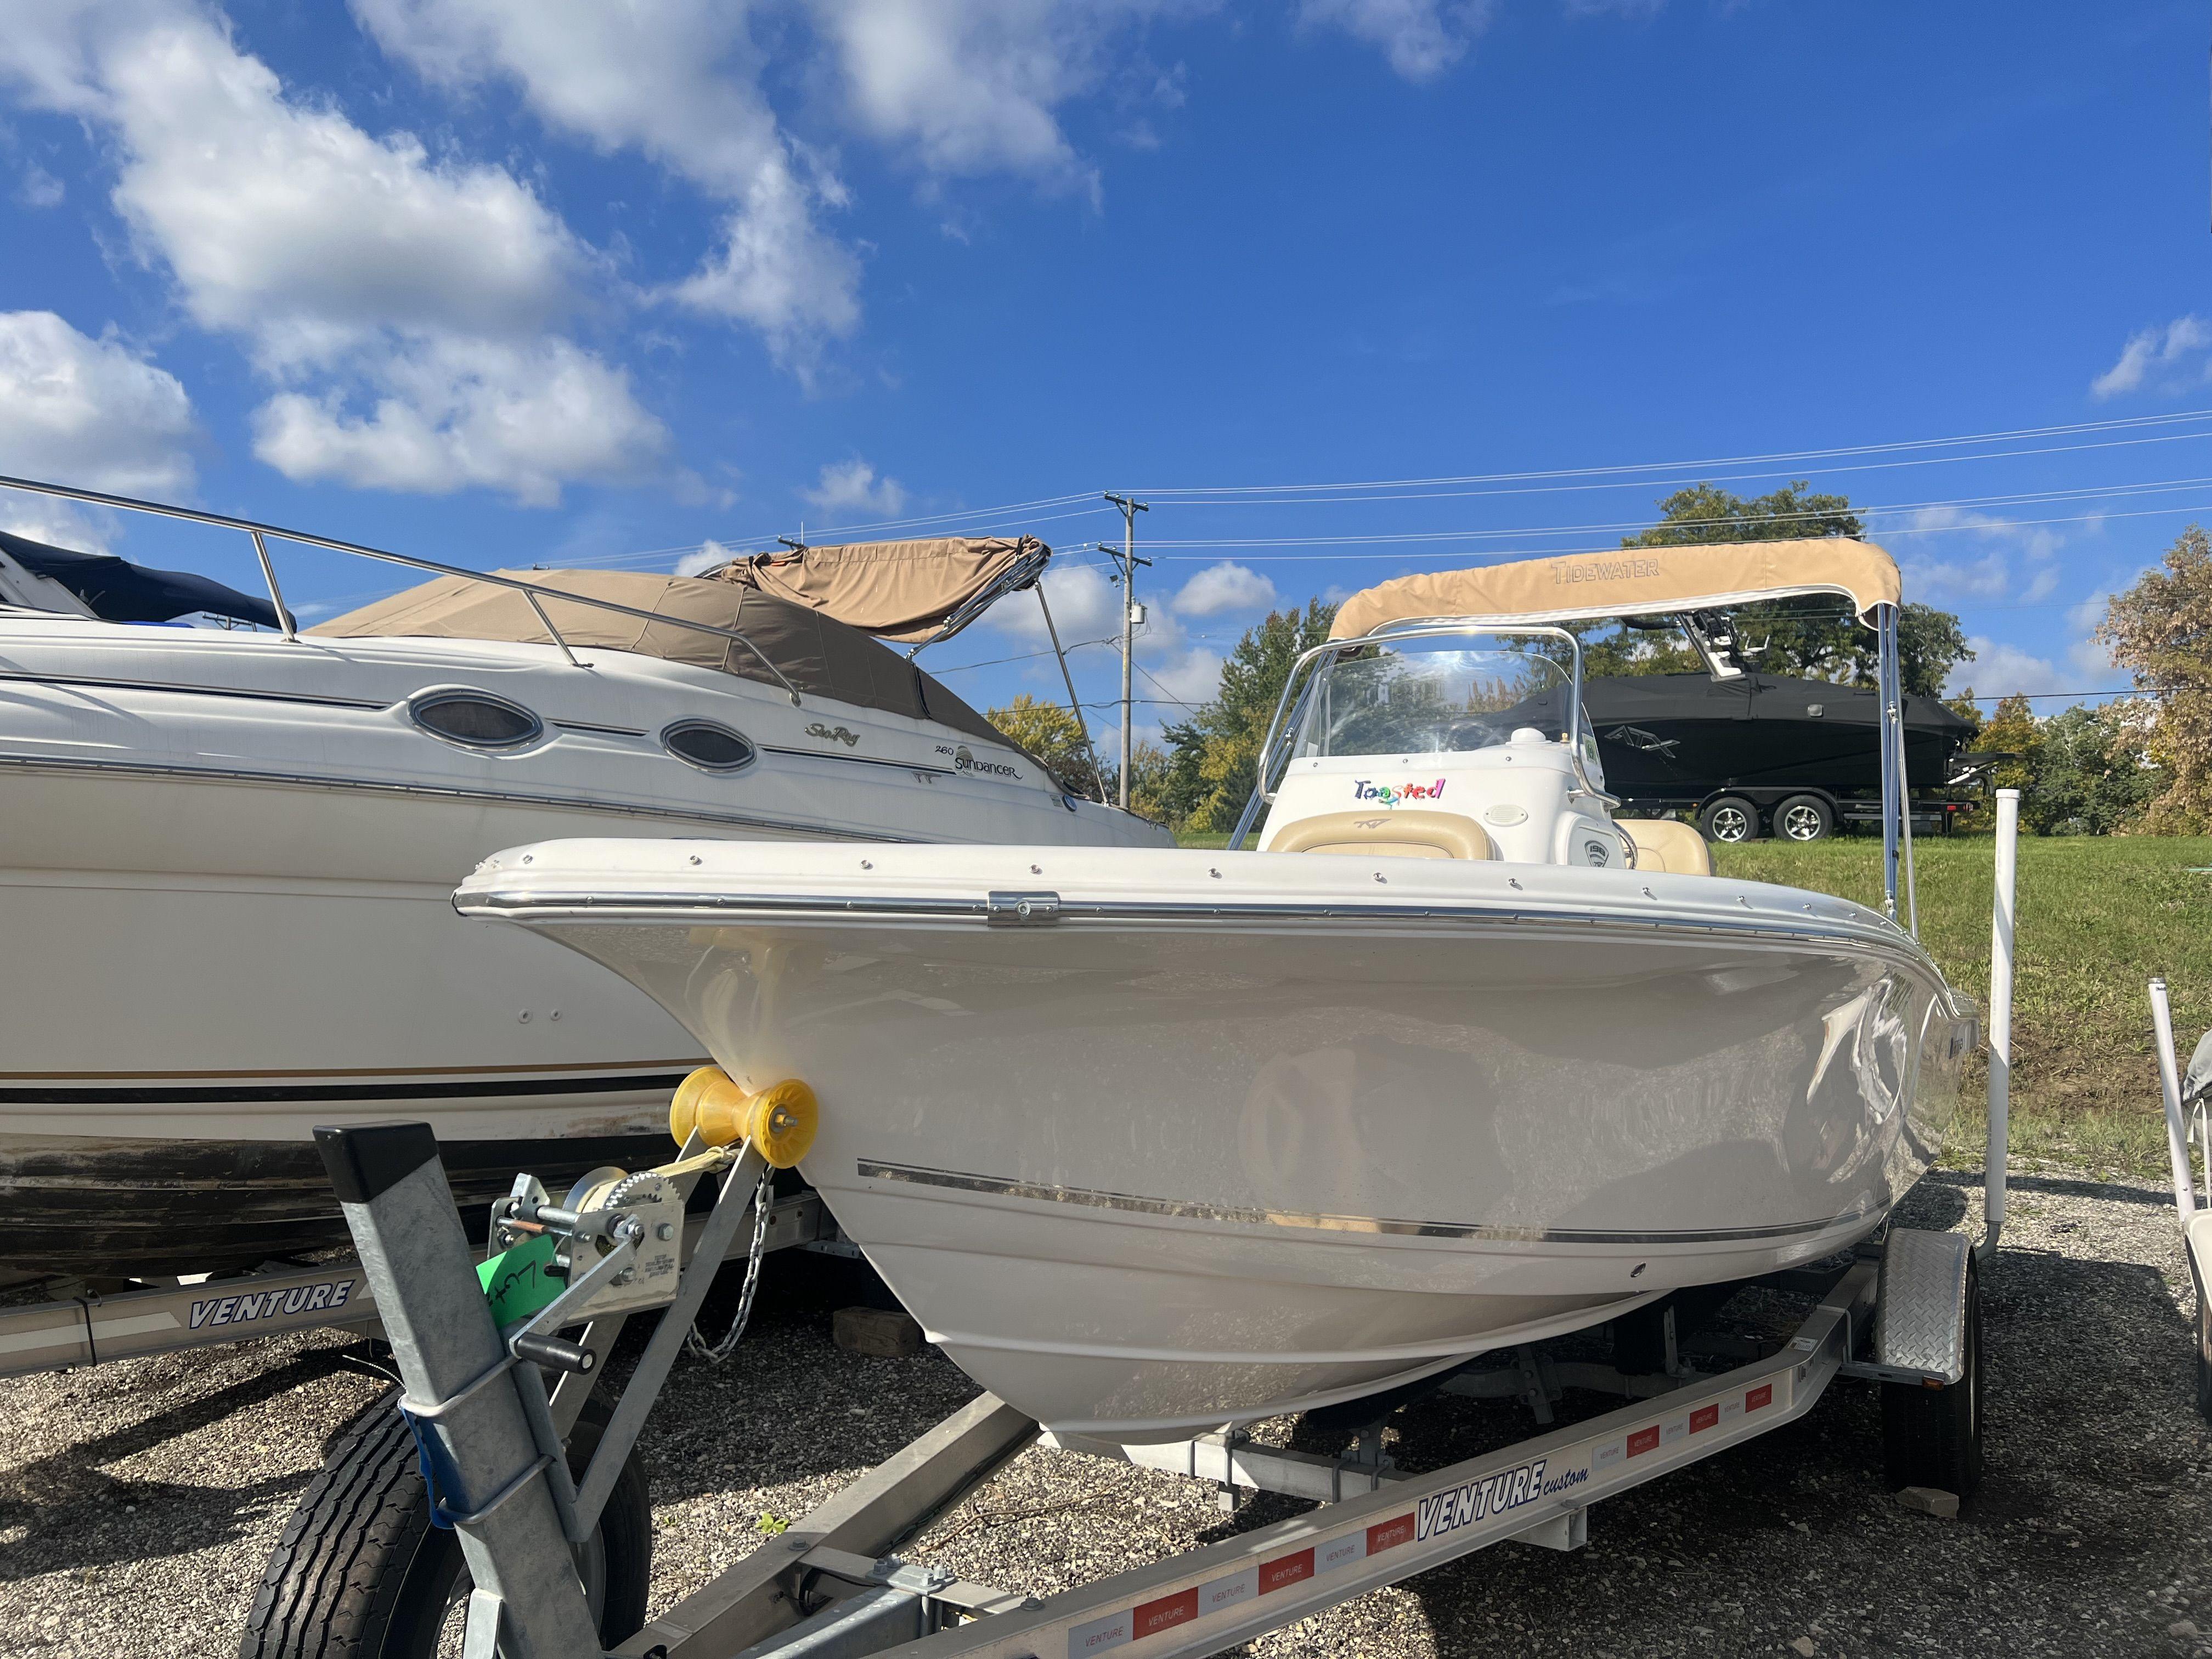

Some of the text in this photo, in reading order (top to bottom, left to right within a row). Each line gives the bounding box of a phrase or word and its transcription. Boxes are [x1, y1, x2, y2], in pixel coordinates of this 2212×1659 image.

[1551, 558, 1660, 584] TIDEWATER
[935, 745, 954, 755] 260
[189, 1279, 356, 1330] VENTURE
[1417, 1459, 1589, 1542] VENTURE custom
[1378, 1526, 1406, 1542] VENTURE
[1326, 1545, 1355, 1562] VENTURE
[1271, 1564, 1303, 1582] VENTURE
[1212, 1583, 1246, 1603] VENTURE
[1148, 1606, 1185, 1627] VENTURE
[1085, 1626, 1124, 1647] VENTURE
